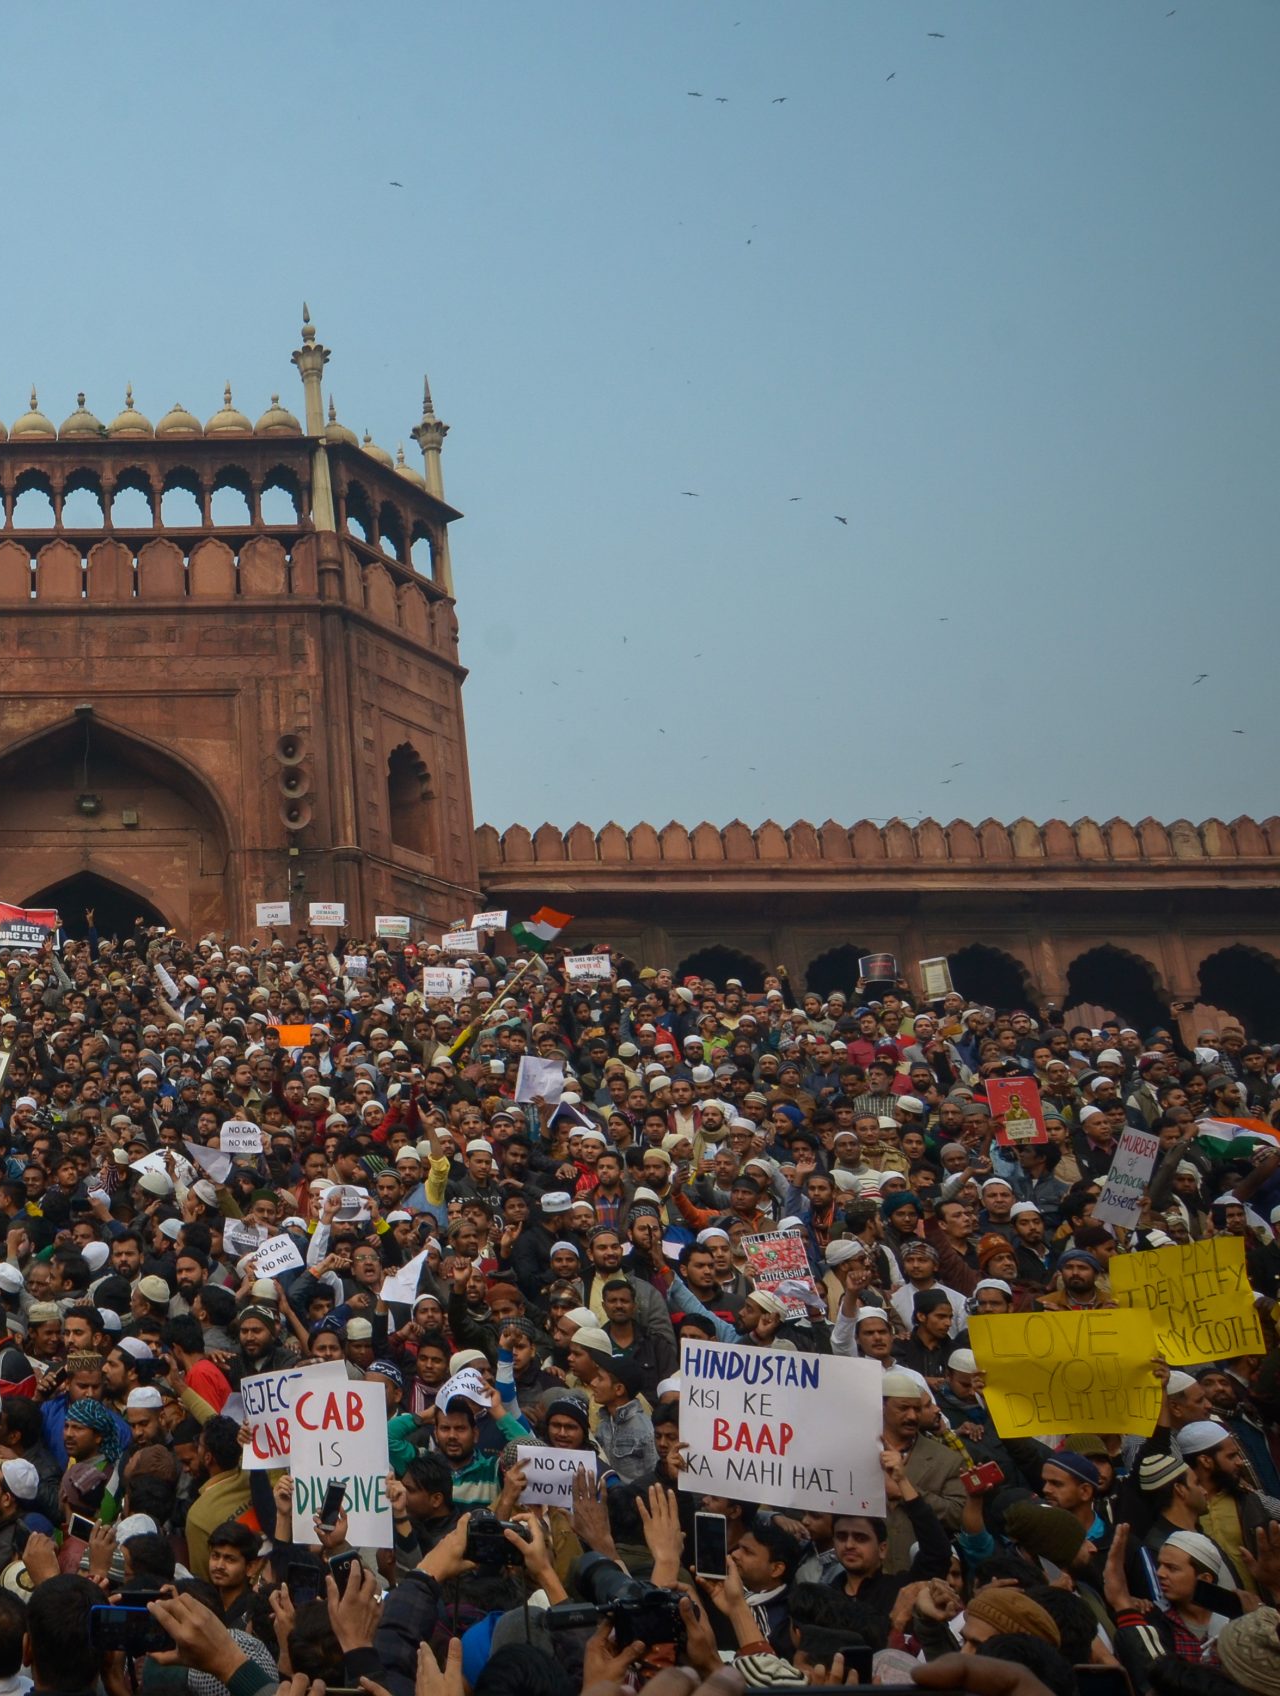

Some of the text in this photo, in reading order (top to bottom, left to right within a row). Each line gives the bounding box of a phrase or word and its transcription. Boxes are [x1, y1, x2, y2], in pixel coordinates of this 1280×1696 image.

[10, 924, 41, 933] REJECT
[22, 933, 30, 941] &
[228, 1126, 258, 1134] NO CAA
[241, 1139, 257, 1147] NRC
[1120, 1134, 1157, 1159] MURDER
[1101, 1187, 1138, 1211] Dissent
[742, 1229, 800, 1245] ROLL BACK THE
[255, 1240, 288, 1261] NO CAA
[262, 1251, 296, 1273] NO NRC
[1129, 1238, 1219, 1282] MR PM
[760, 1270, 806, 1282] CITIZENSHIP
[1167, 1297, 1213, 1329] ME
[984, 1312, 1120, 1359] LOVE
[684, 1346, 820, 1390] HINDUSTAN
[1030, 1356, 1121, 1396] YOU
[441, 1380, 454, 1394] NO
[445, 1383, 483, 1398] NO NRC
[295, 1391, 366, 1432] CAB
[688, 1385, 774, 1417] KISI KE
[1005, 1390, 1096, 1428] DELHI
[251, 1416, 291, 1460] CAB
[712, 1417, 794, 1456] BAAP
[319, 1441, 343, 1468] IS
[534, 1457, 555, 1471] NO
[684, 1451, 713, 1478] KA
[726, 1457, 783, 1487] NAHI
[792, 1465, 839, 1493] HAI
[532, 1482, 554, 1495] NO
